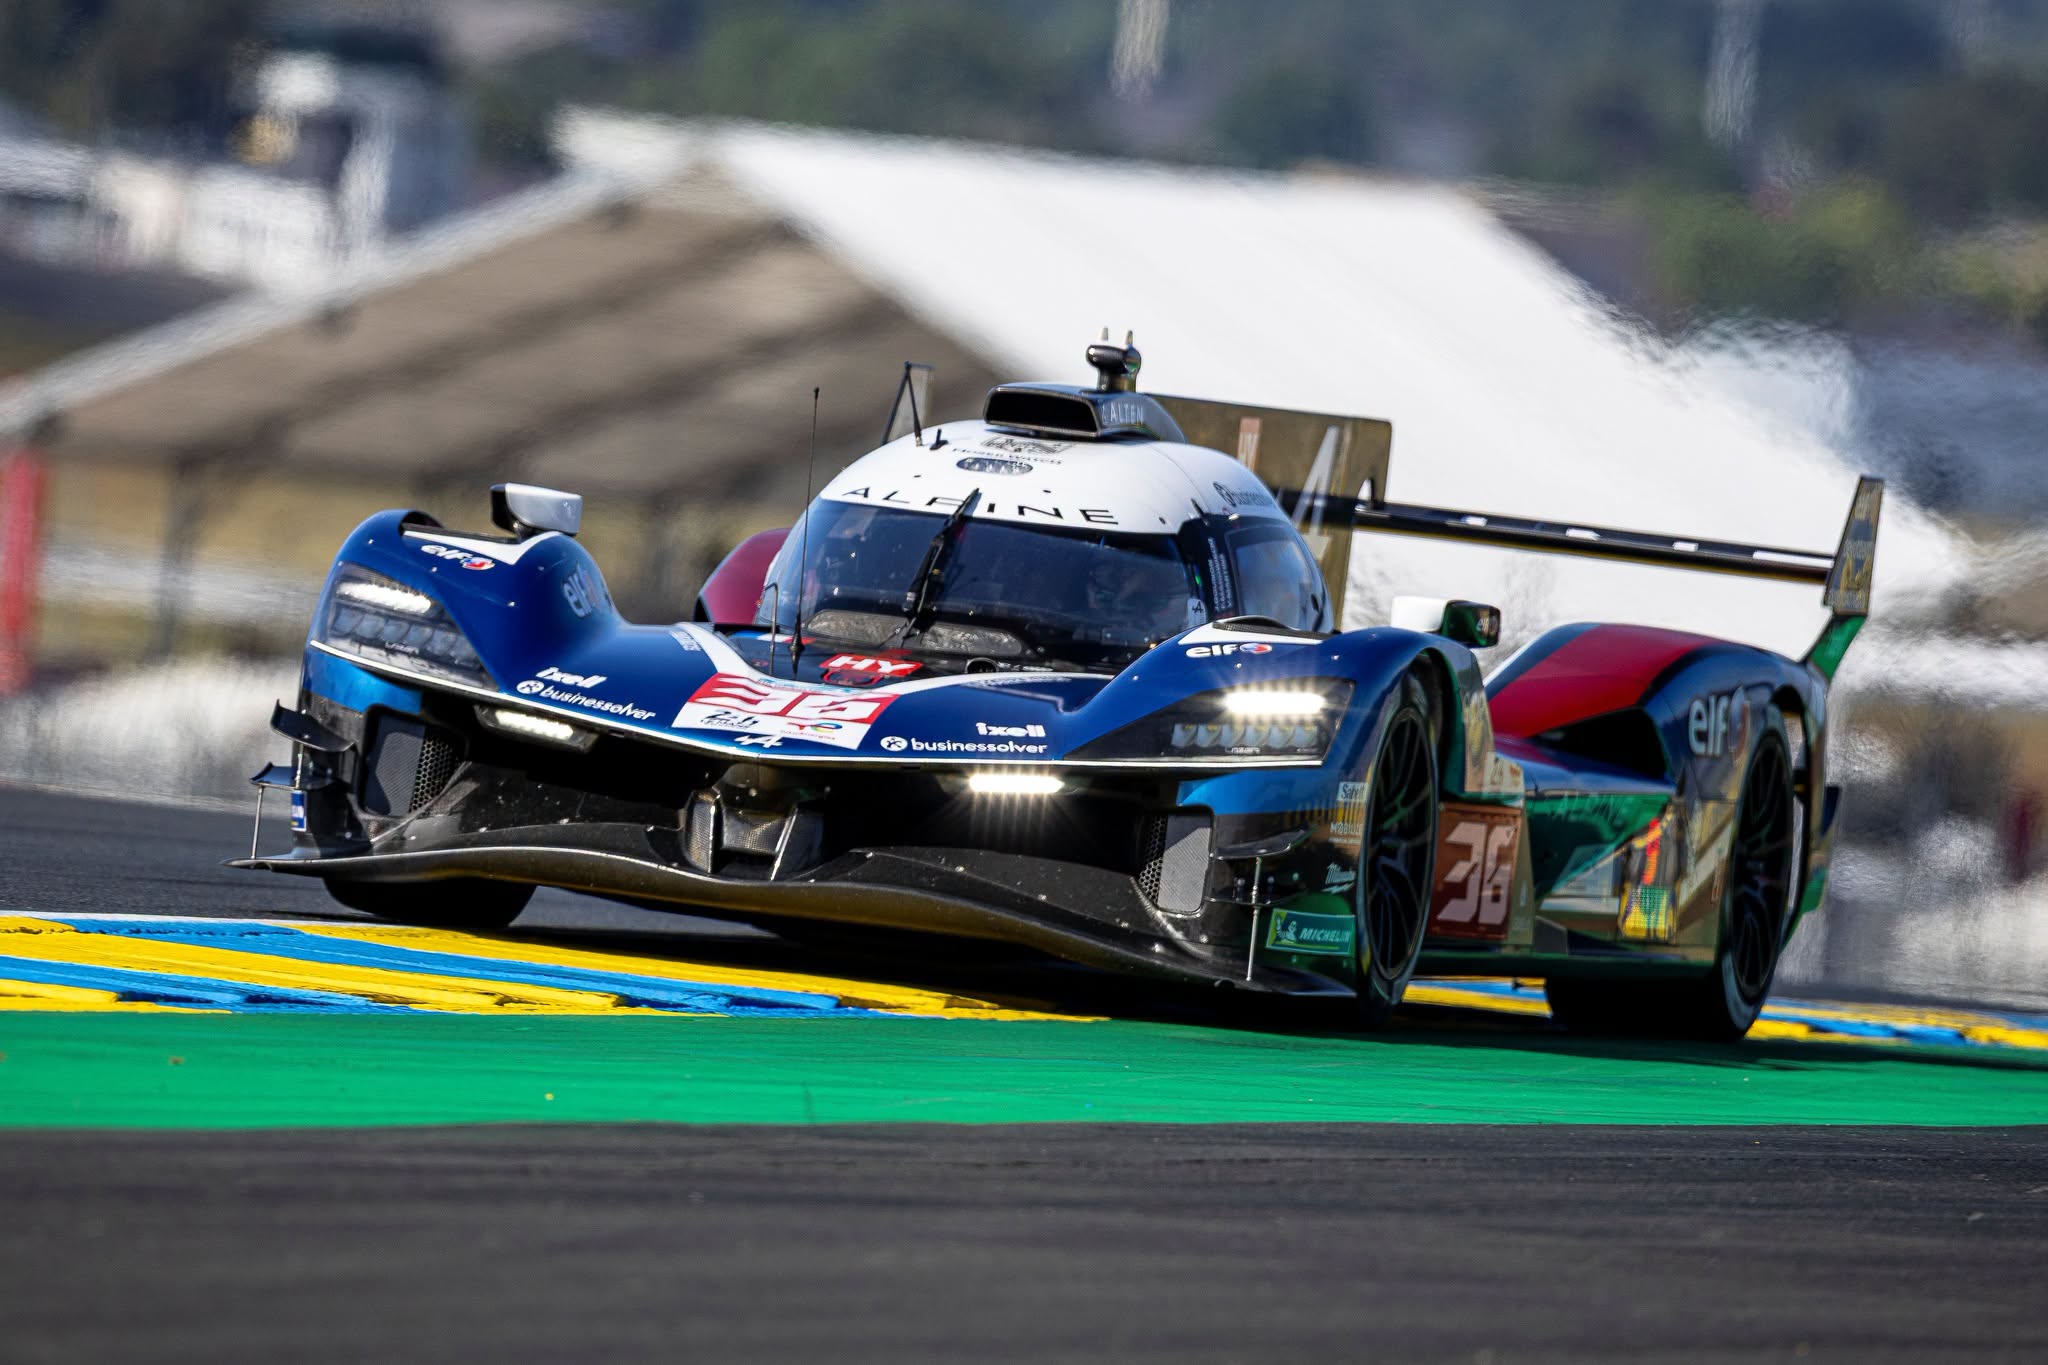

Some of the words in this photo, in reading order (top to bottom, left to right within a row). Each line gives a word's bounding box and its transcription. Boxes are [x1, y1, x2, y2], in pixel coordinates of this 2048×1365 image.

[841, 487, 1118, 525] ALPINE
[421, 545, 473, 560] elf
[1185, 644, 1239, 658] elf
[828, 656, 917, 674] HY
[539, 685, 656, 720] businessolver
[695, 677, 901, 721] 36
[1687, 694, 1729, 756] elf
[911, 737, 1048, 753] businessolver
[1437, 822, 1515, 925] 36
[1299, 927, 1352, 943] MICHELIN
